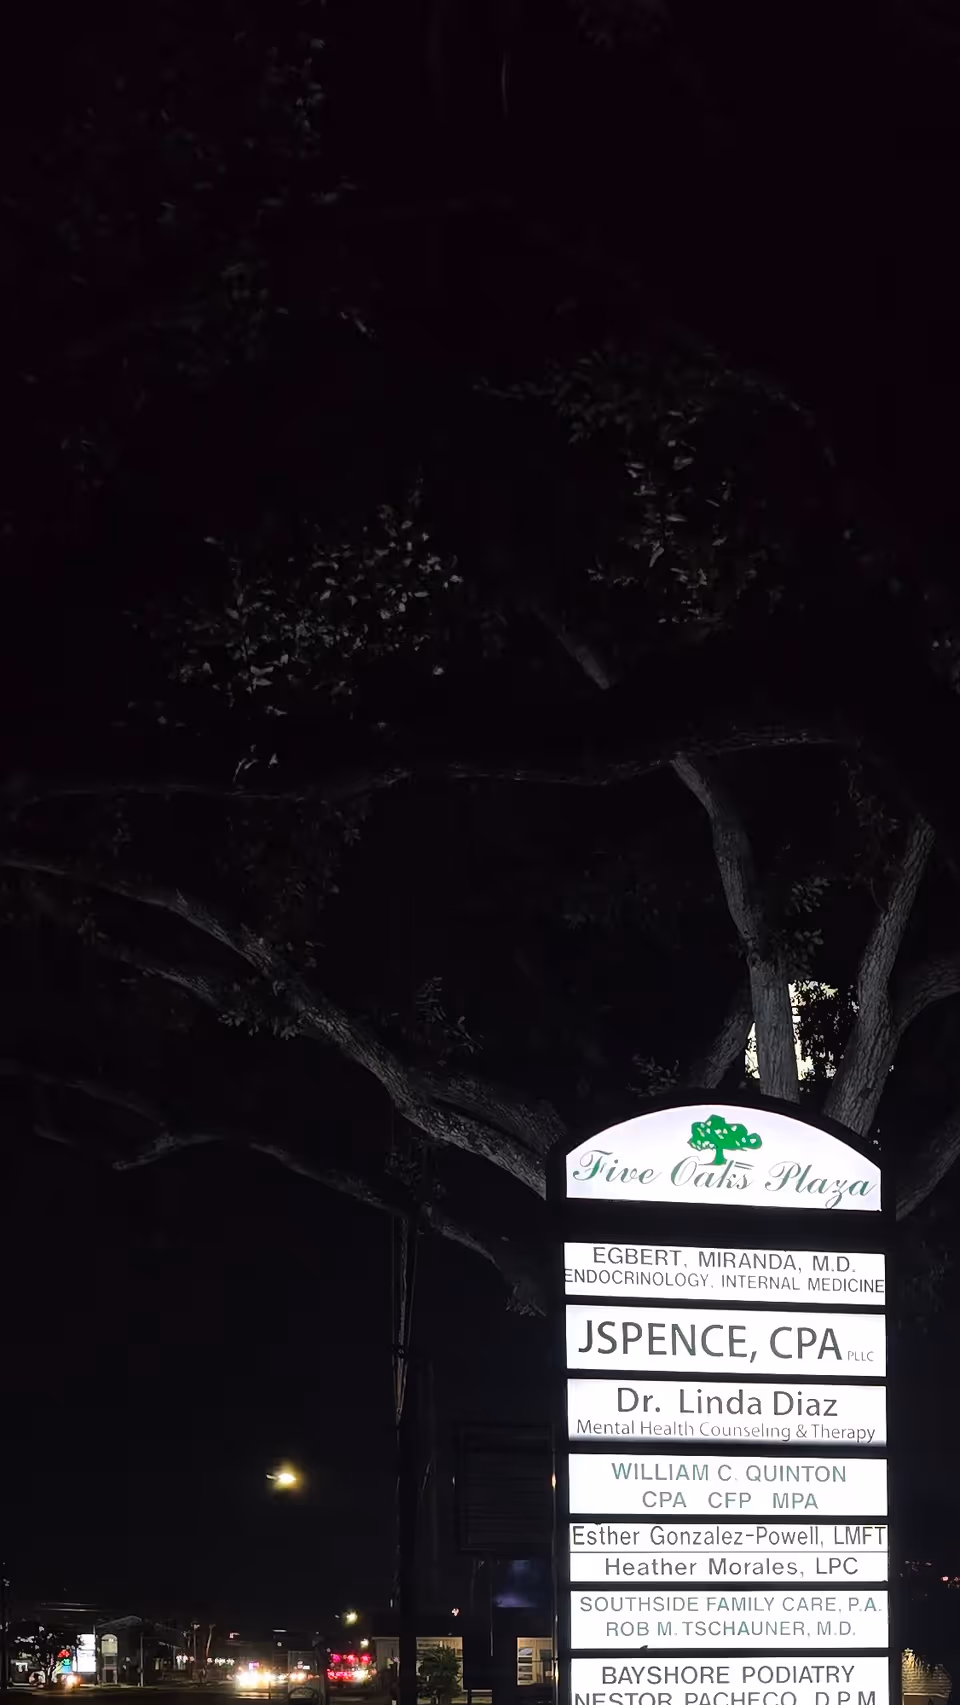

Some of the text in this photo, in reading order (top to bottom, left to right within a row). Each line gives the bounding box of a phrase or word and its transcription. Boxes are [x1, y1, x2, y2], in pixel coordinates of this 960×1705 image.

[572, 1149, 878, 1209] Five Oaks Plaza
[699, 1251, 801, 1272] MIRANDA,
[813, 1256, 855, 1272] M.D.
[722, 1275, 800, 1290] INTERNAL
[808, 1278, 884, 1293] MEDICINE
[578, 1320, 873, 1363] JSPENCE, CPA PLLC
[618, 1388, 837, 1416] Dr. Linda Diaz
[577, 1419, 875, 1442] Mental Health Counseling & Therapy
[611, 1463, 845, 1482] WILLIAM C. QUINTON
[643, 1491, 818, 1509] CPA CFP MPA
[572, 1526, 886, 1546] Esther Gonzalez-Powell, LMFT
[606, 1557, 858, 1577] Heather Morales, LPC
[581, 1597, 698, 1611] SOUTHSIDE
[707, 1597, 774, 1611] FAMILY
[848, 1597, 882, 1612] P.A.
[607, 1622, 649, 1636] ROB
[658, 1622, 677, 1635] M.
[818, 1621, 855, 1635] M.D.
[603, 1666, 854, 1684] BAYSHORE PODIATRY
